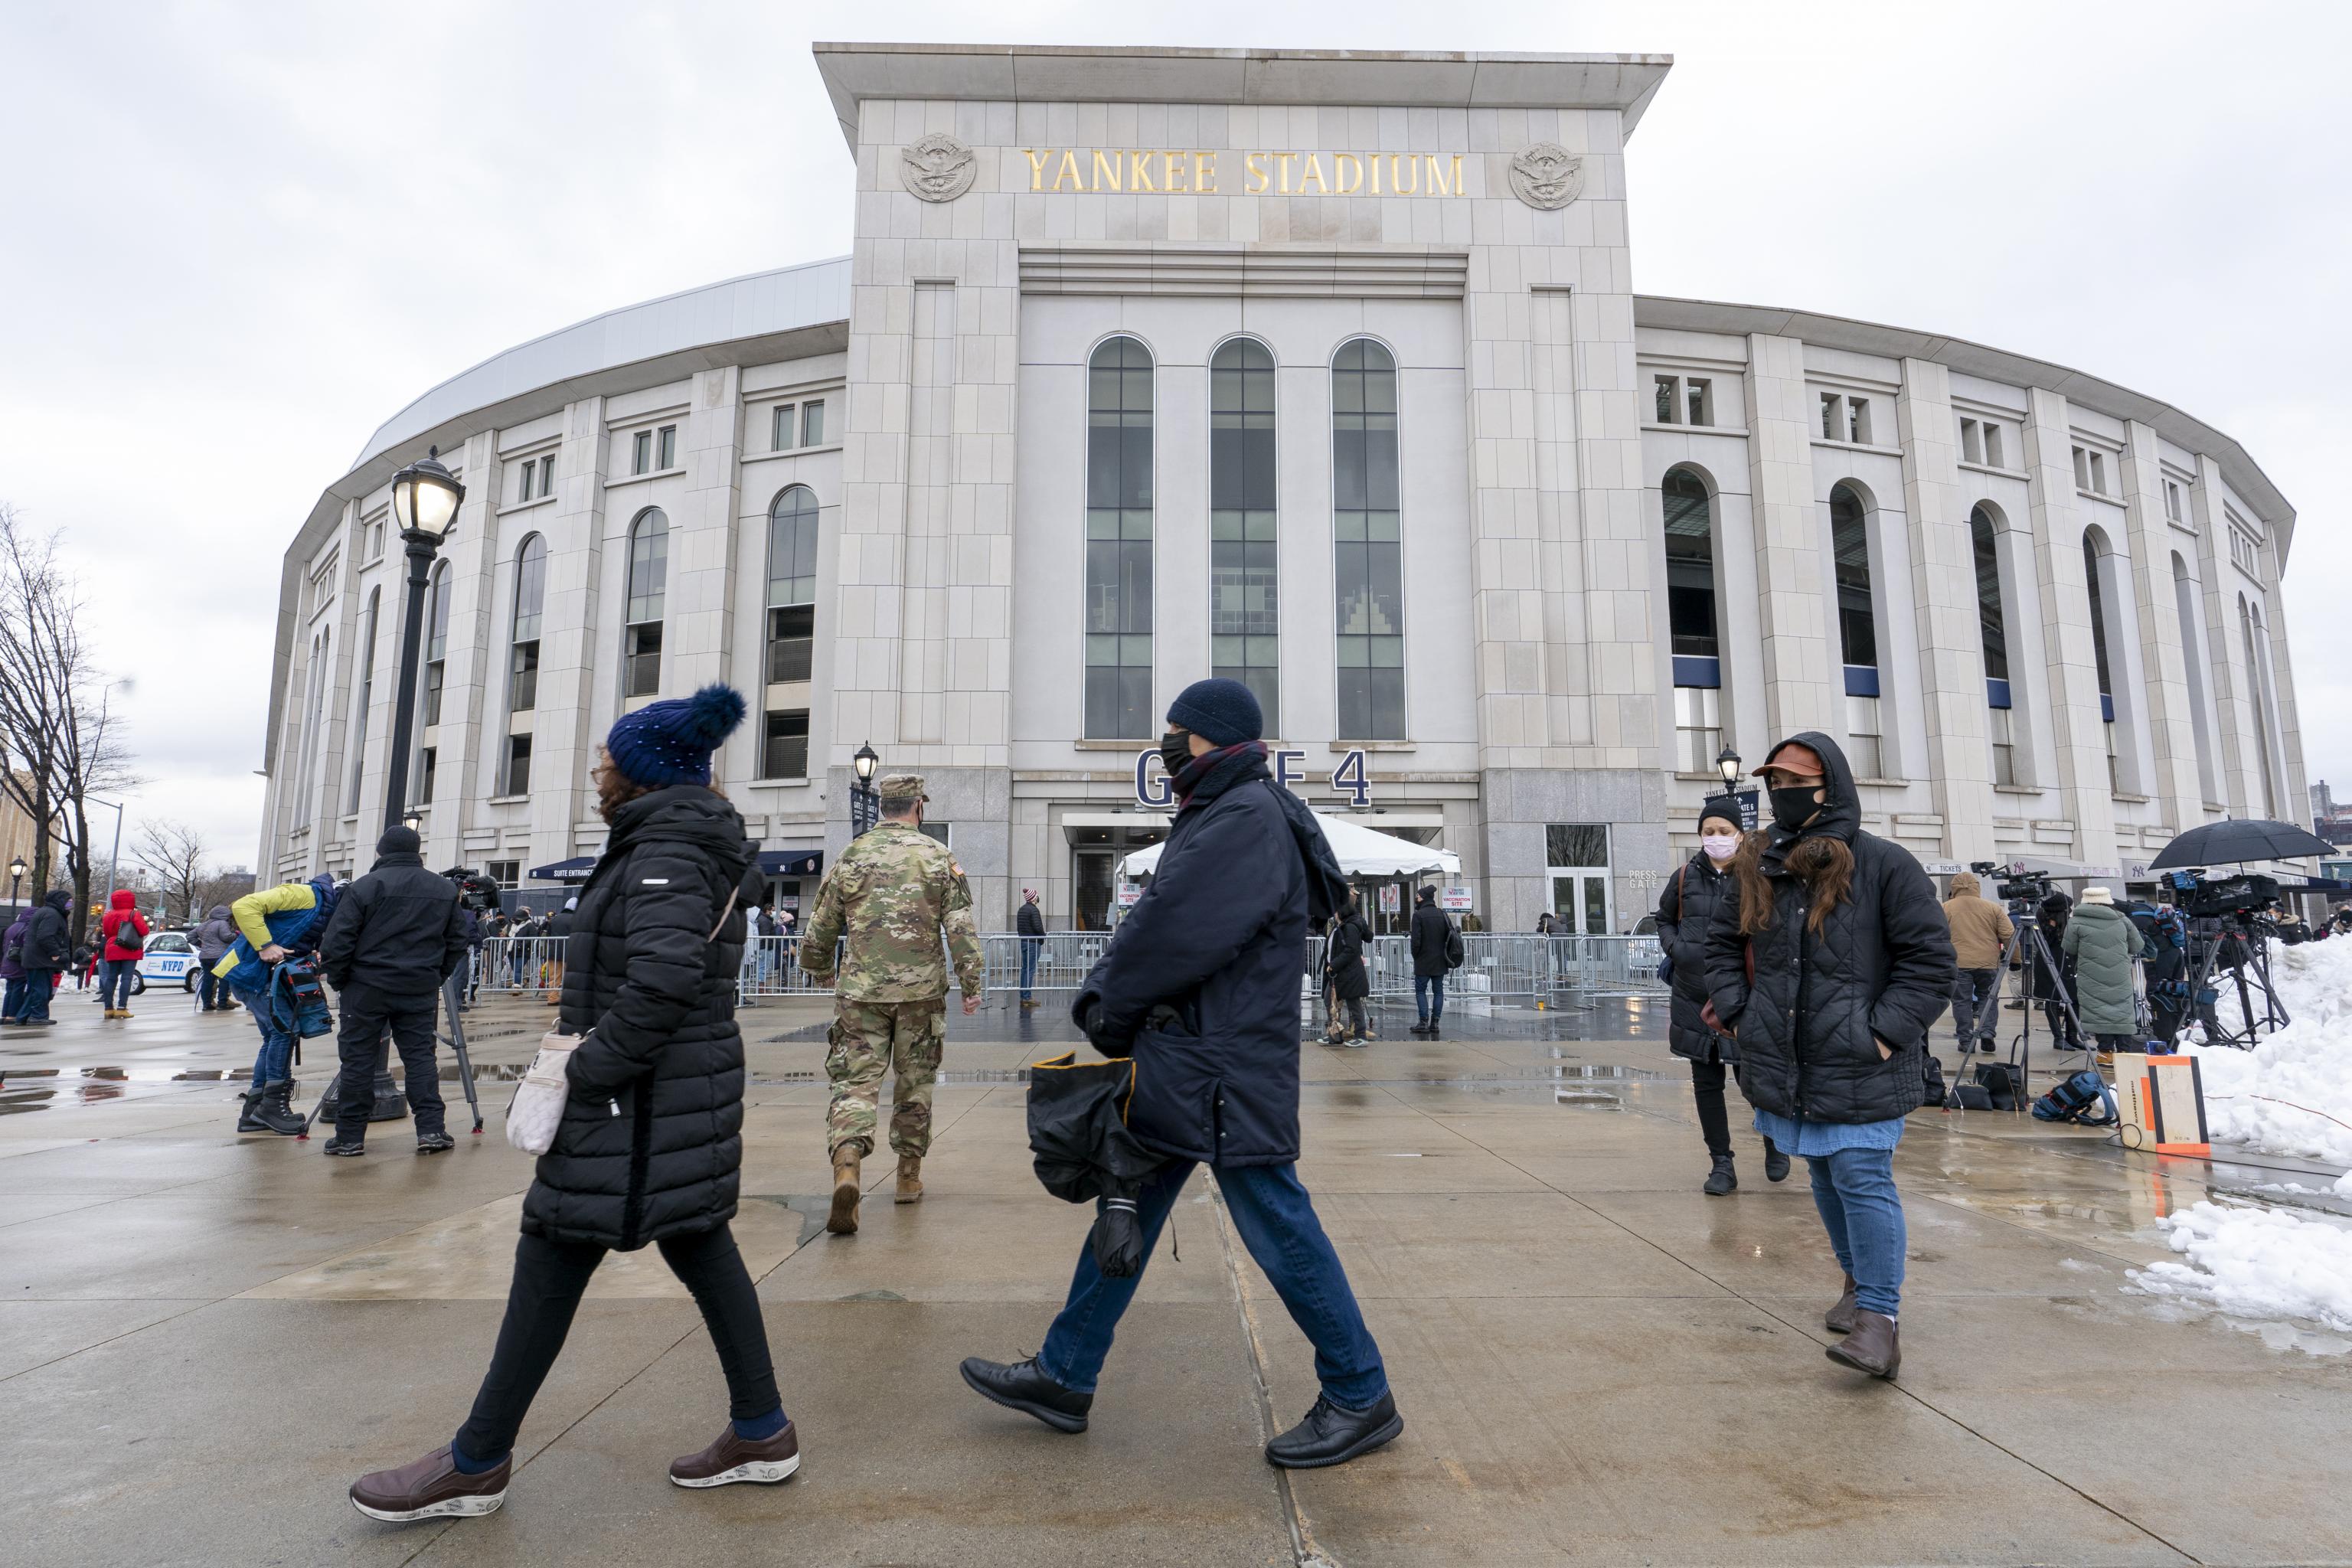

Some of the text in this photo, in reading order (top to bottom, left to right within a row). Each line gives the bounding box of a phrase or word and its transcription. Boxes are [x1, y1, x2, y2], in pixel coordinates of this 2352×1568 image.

[1021, 150, 1466, 196] YANKEE STADIUM
[1135, 748, 1371, 807] GE 4
[1705, 784, 1758, 798] YANKEE STADIUM
[1628, 870, 1657, 880] PRESS
[1629, 879, 1658, 889] GATE
[161, 960, 184, 972] NYPD
